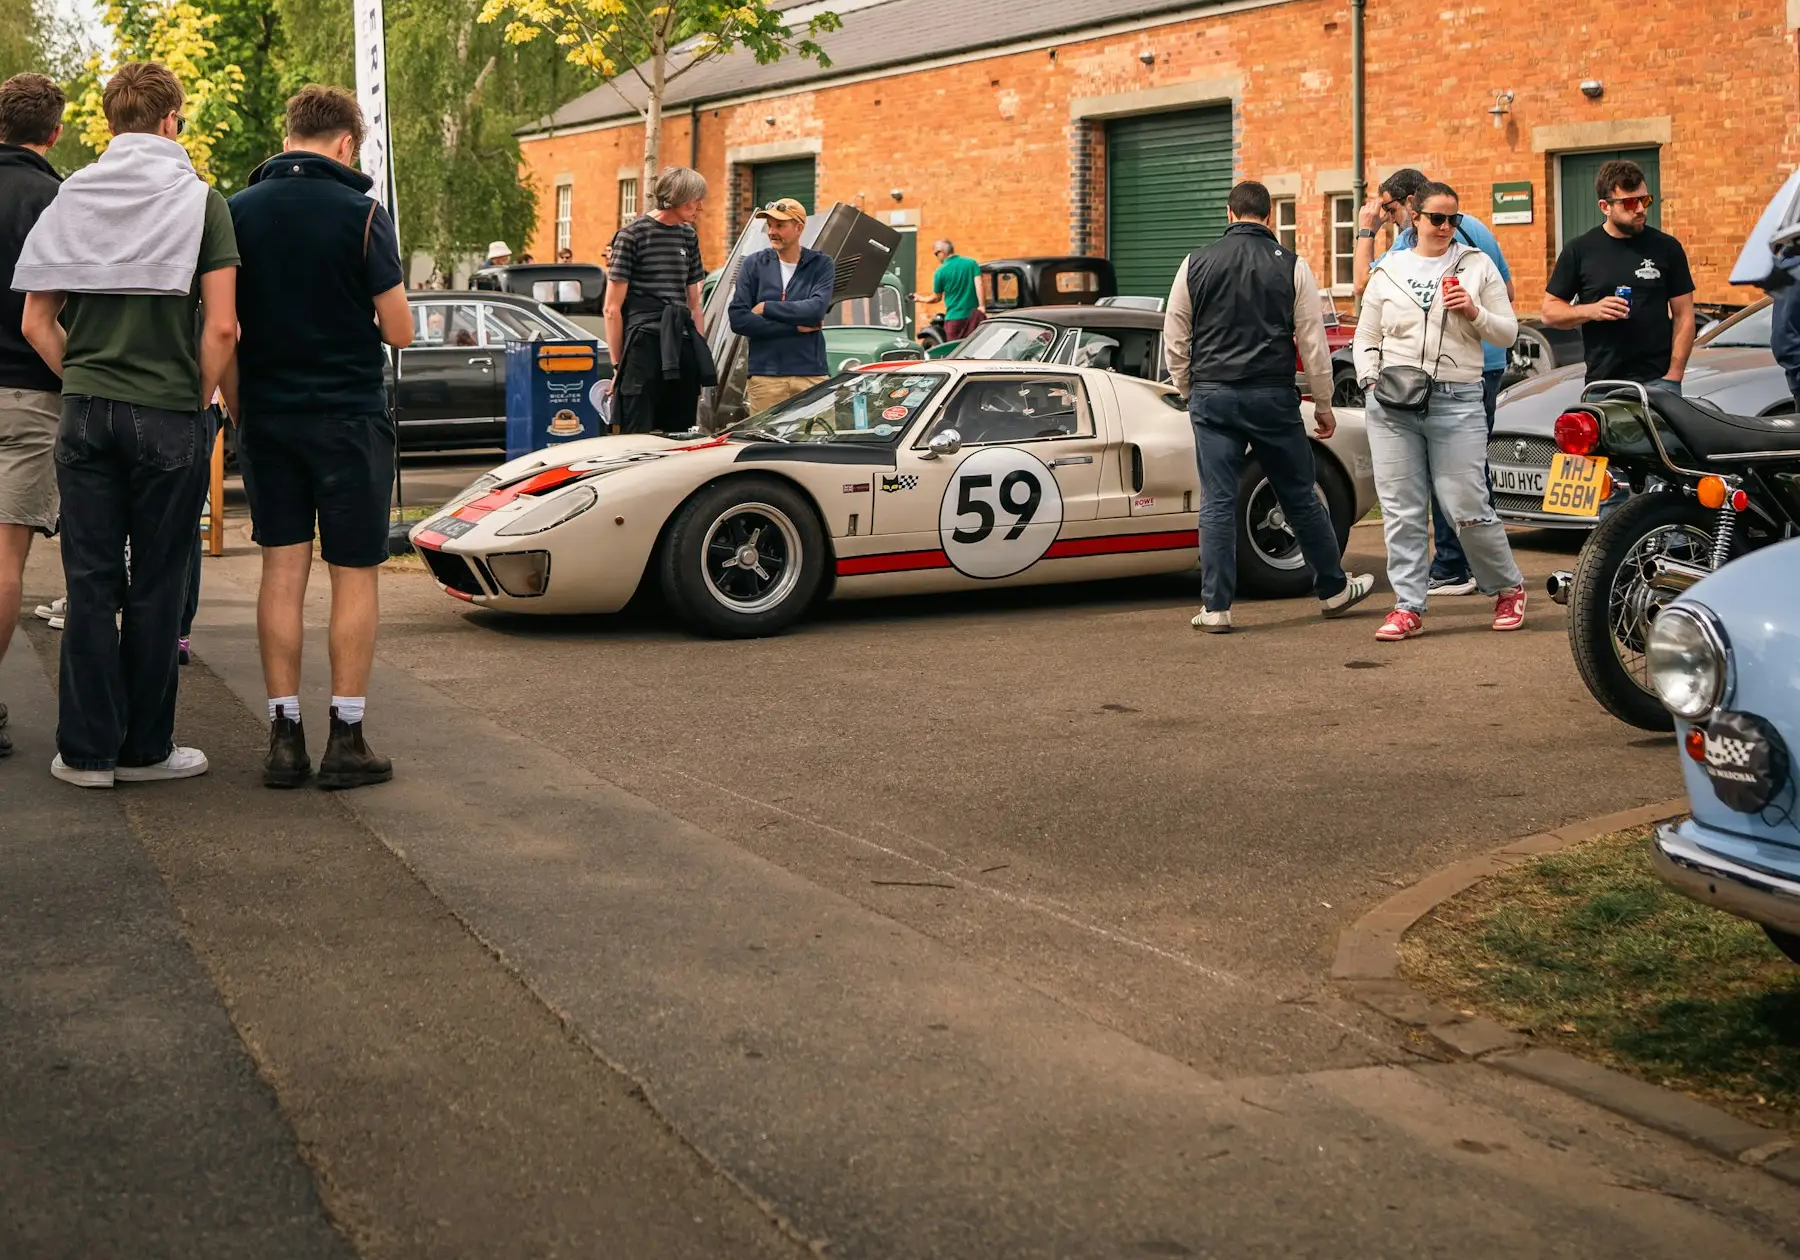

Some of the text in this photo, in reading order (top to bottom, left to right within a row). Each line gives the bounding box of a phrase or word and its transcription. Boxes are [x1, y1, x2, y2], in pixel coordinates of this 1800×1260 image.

[1518, 472, 1543, 491] HYC
[1560, 456, 1597, 482] WHJ
[952, 469, 1042, 544] 59
[1134, 497, 1154, 507] ROWE
[1548, 482, 1597, 510] 568M
